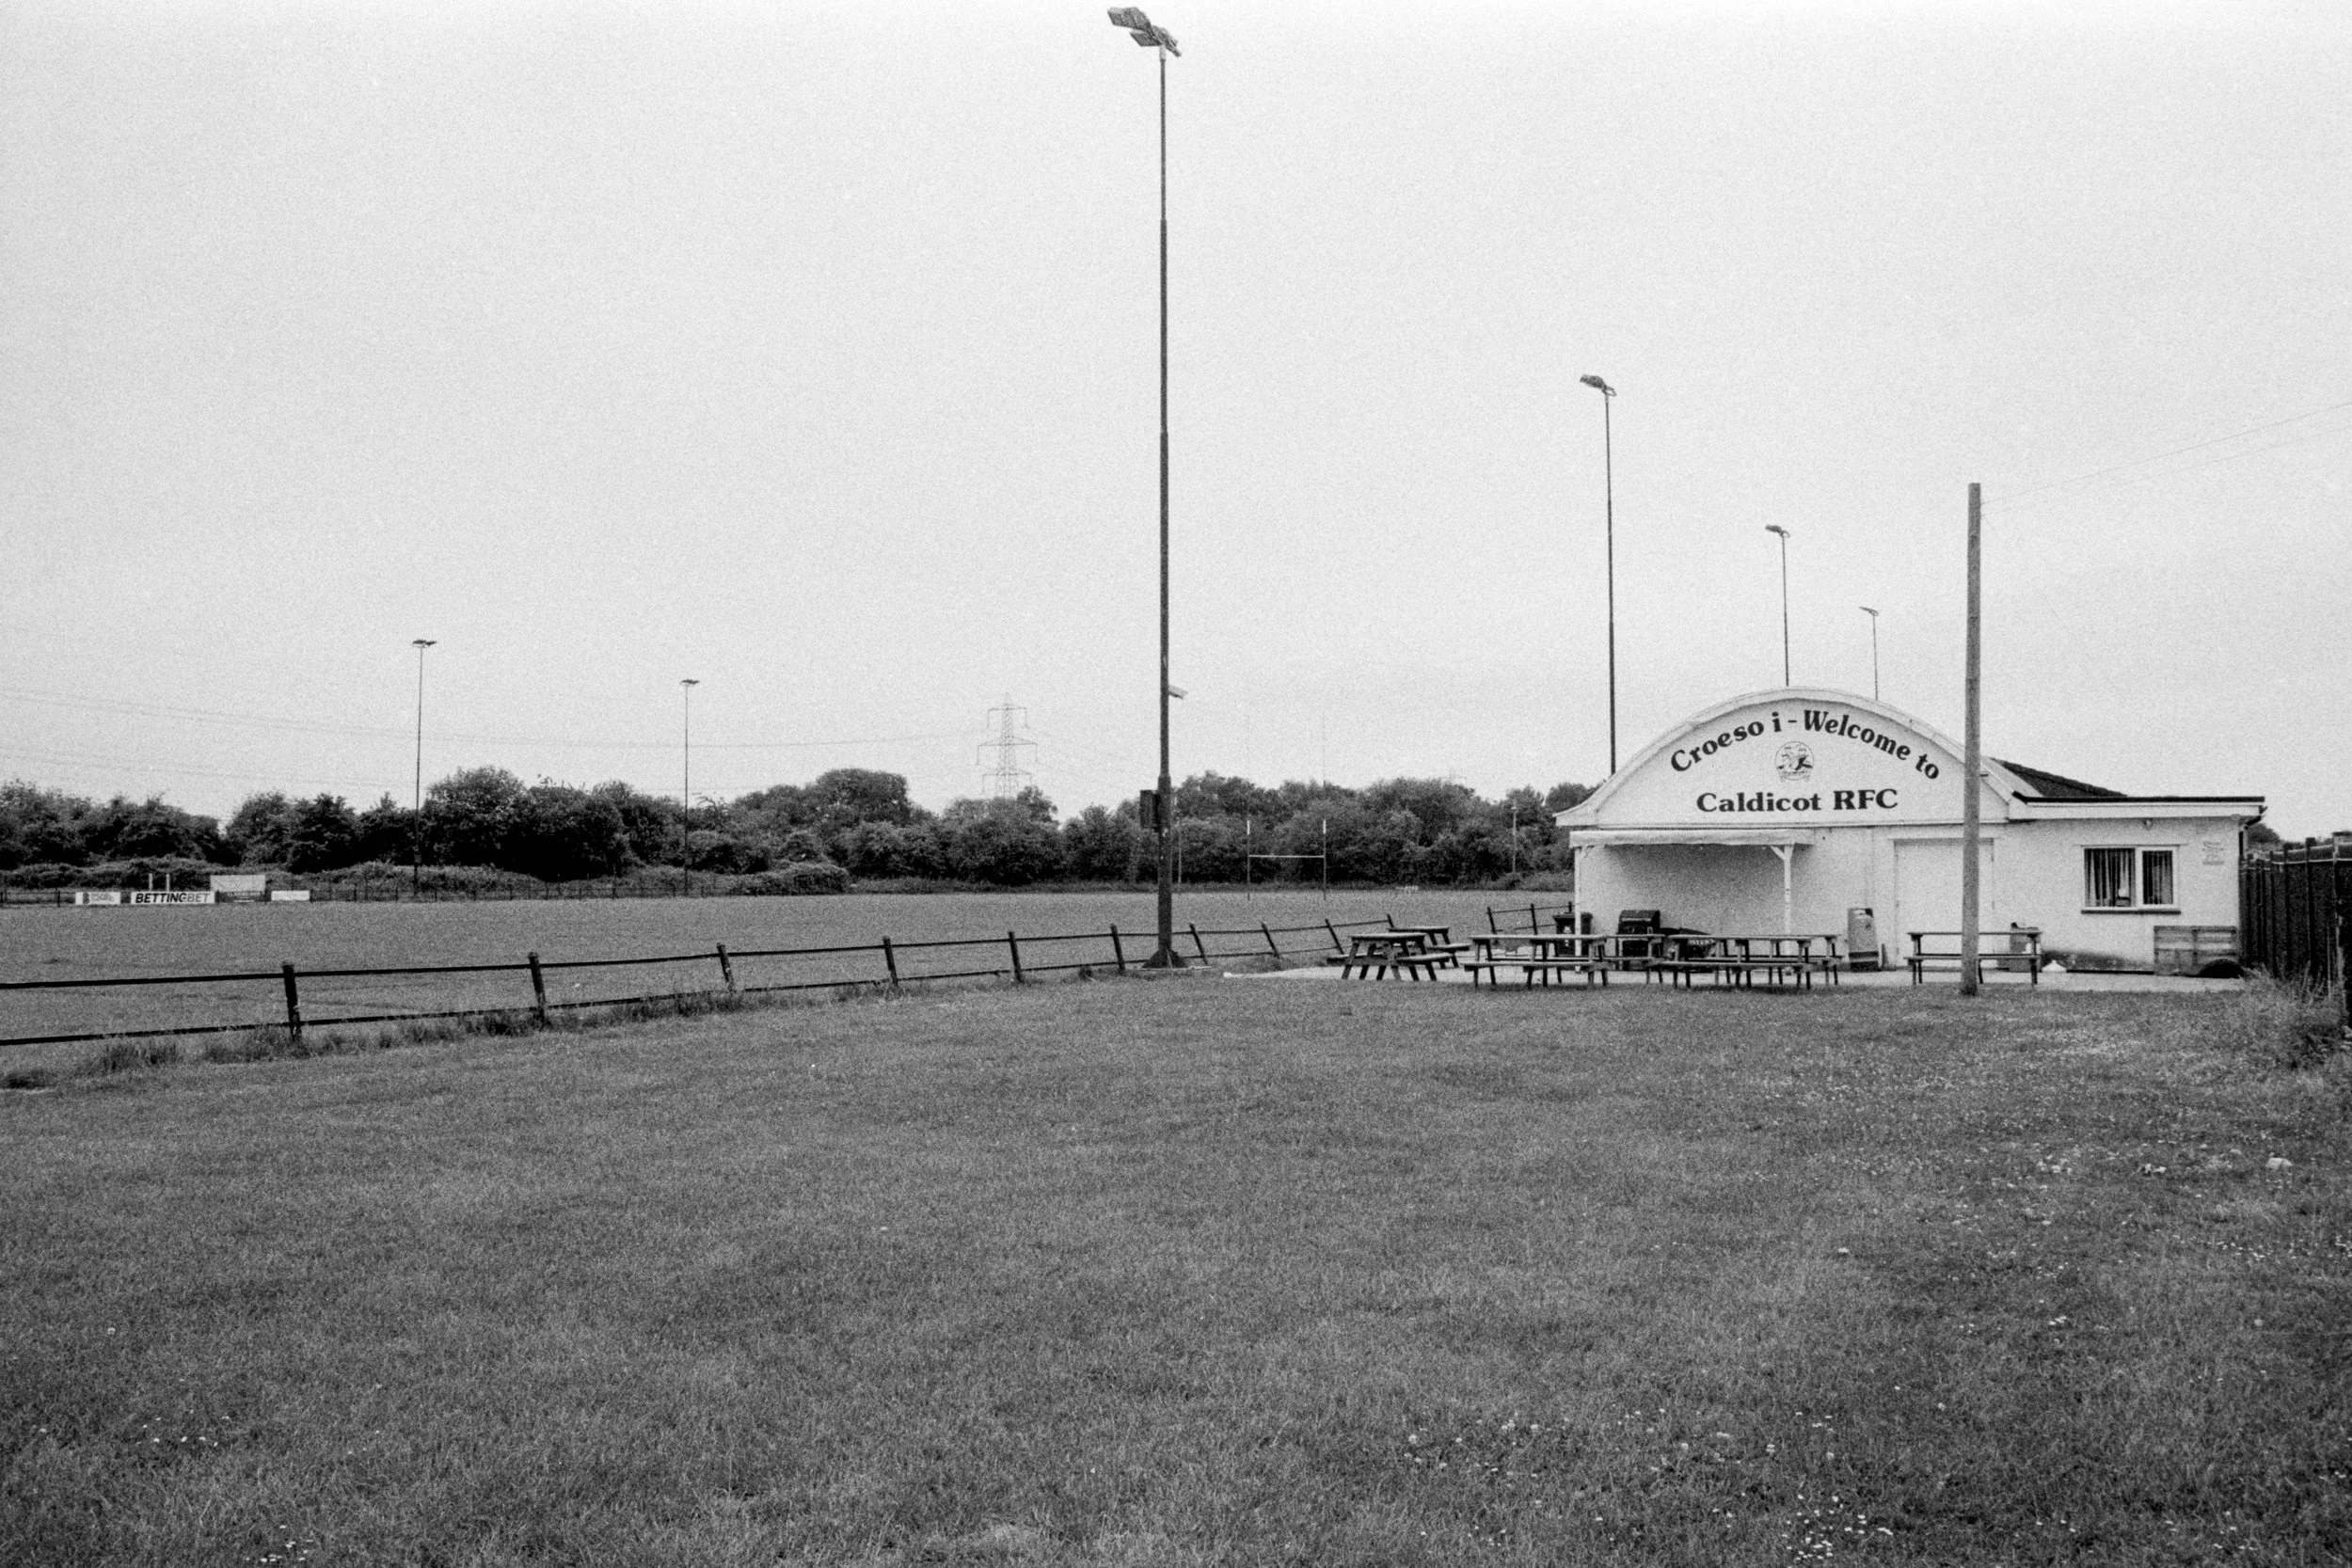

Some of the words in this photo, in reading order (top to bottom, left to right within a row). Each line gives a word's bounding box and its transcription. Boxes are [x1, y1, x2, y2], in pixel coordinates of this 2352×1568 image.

[1670, 721, 1765, 772] Croeso
[1771, 710, 1783, 733] i
[1803, 708, 1912, 761] Welcome
[1915, 753, 1940, 780] to
[1696, 791, 1822, 813] Caldicot
[1833, 788, 1899, 811] RFC
